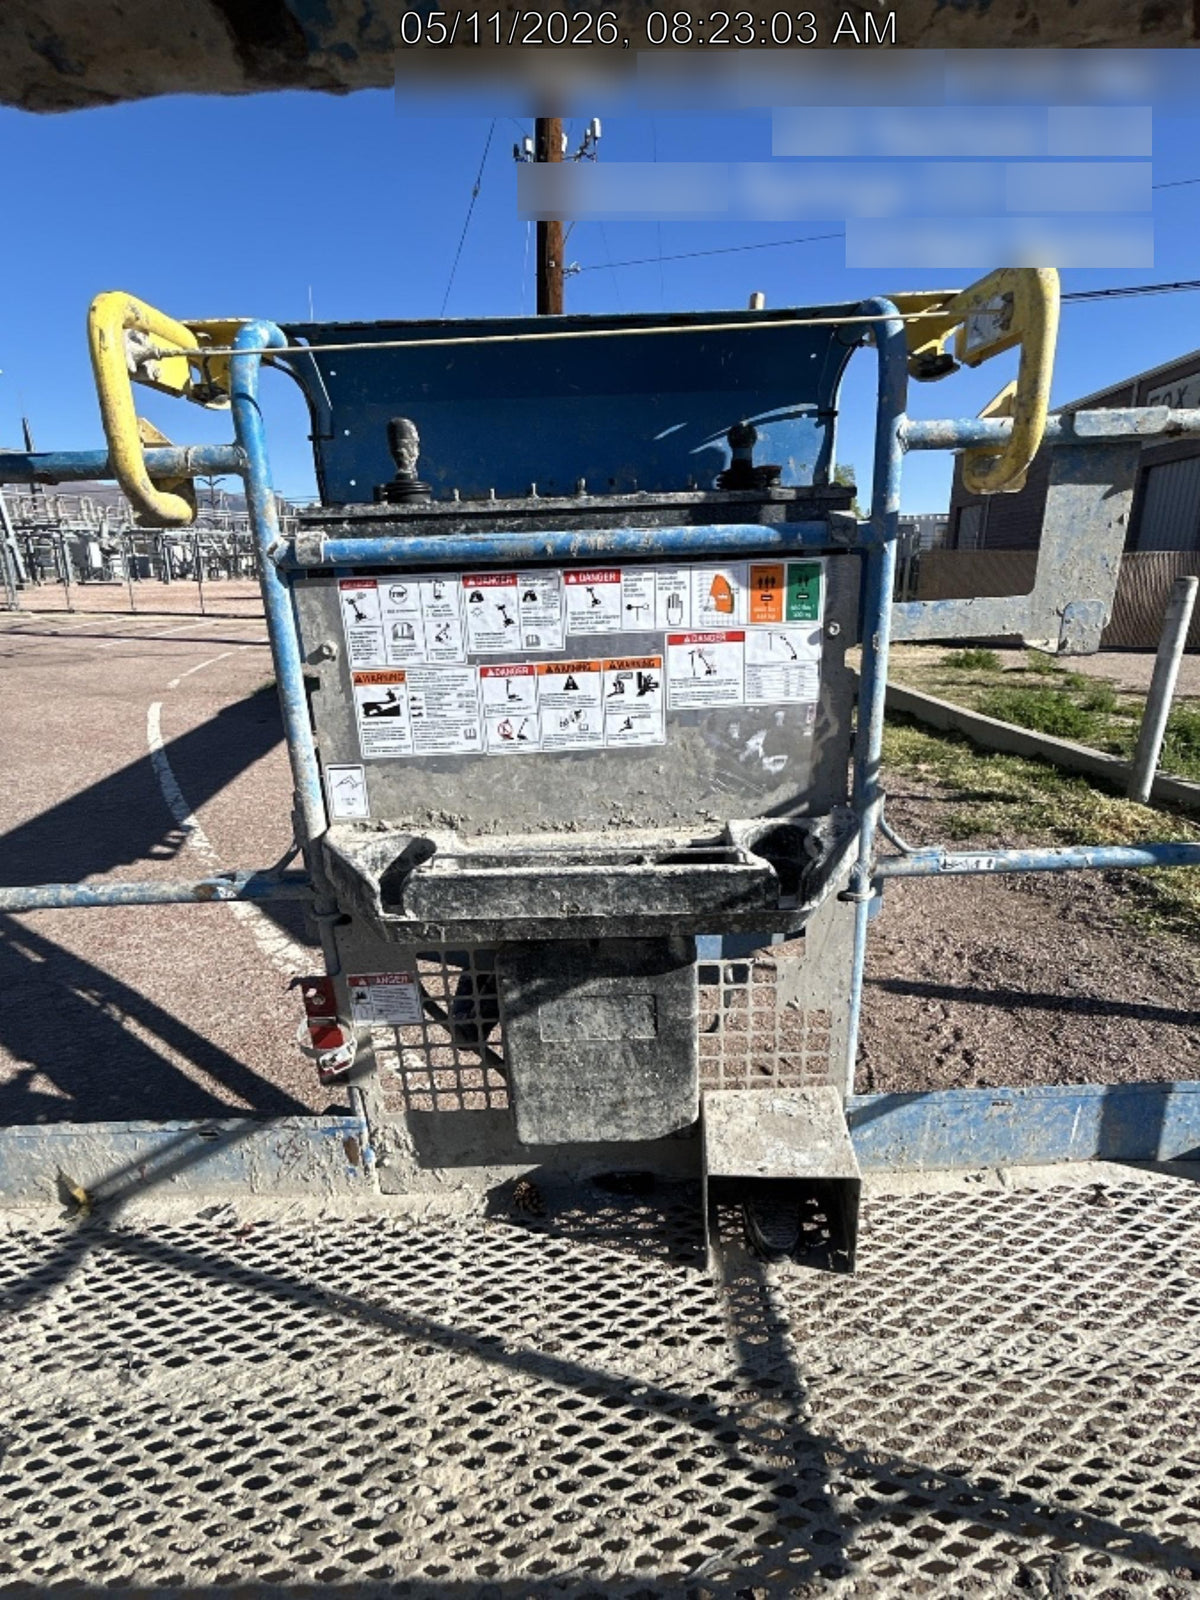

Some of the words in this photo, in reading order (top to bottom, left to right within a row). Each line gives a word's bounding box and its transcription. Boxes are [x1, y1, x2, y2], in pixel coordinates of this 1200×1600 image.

[476, 575, 513, 586] DANGER
[579, 572, 616, 582] DANGER
[692, 633, 727, 642] DANGER
[551, 662, 592, 673] WARNING
[614, 659, 656, 669] WARNING
[495, 666, 529, 676] DANGER
[362, 672, 405, 684] WARNING
[374, 974, 409, 985] ANGER
